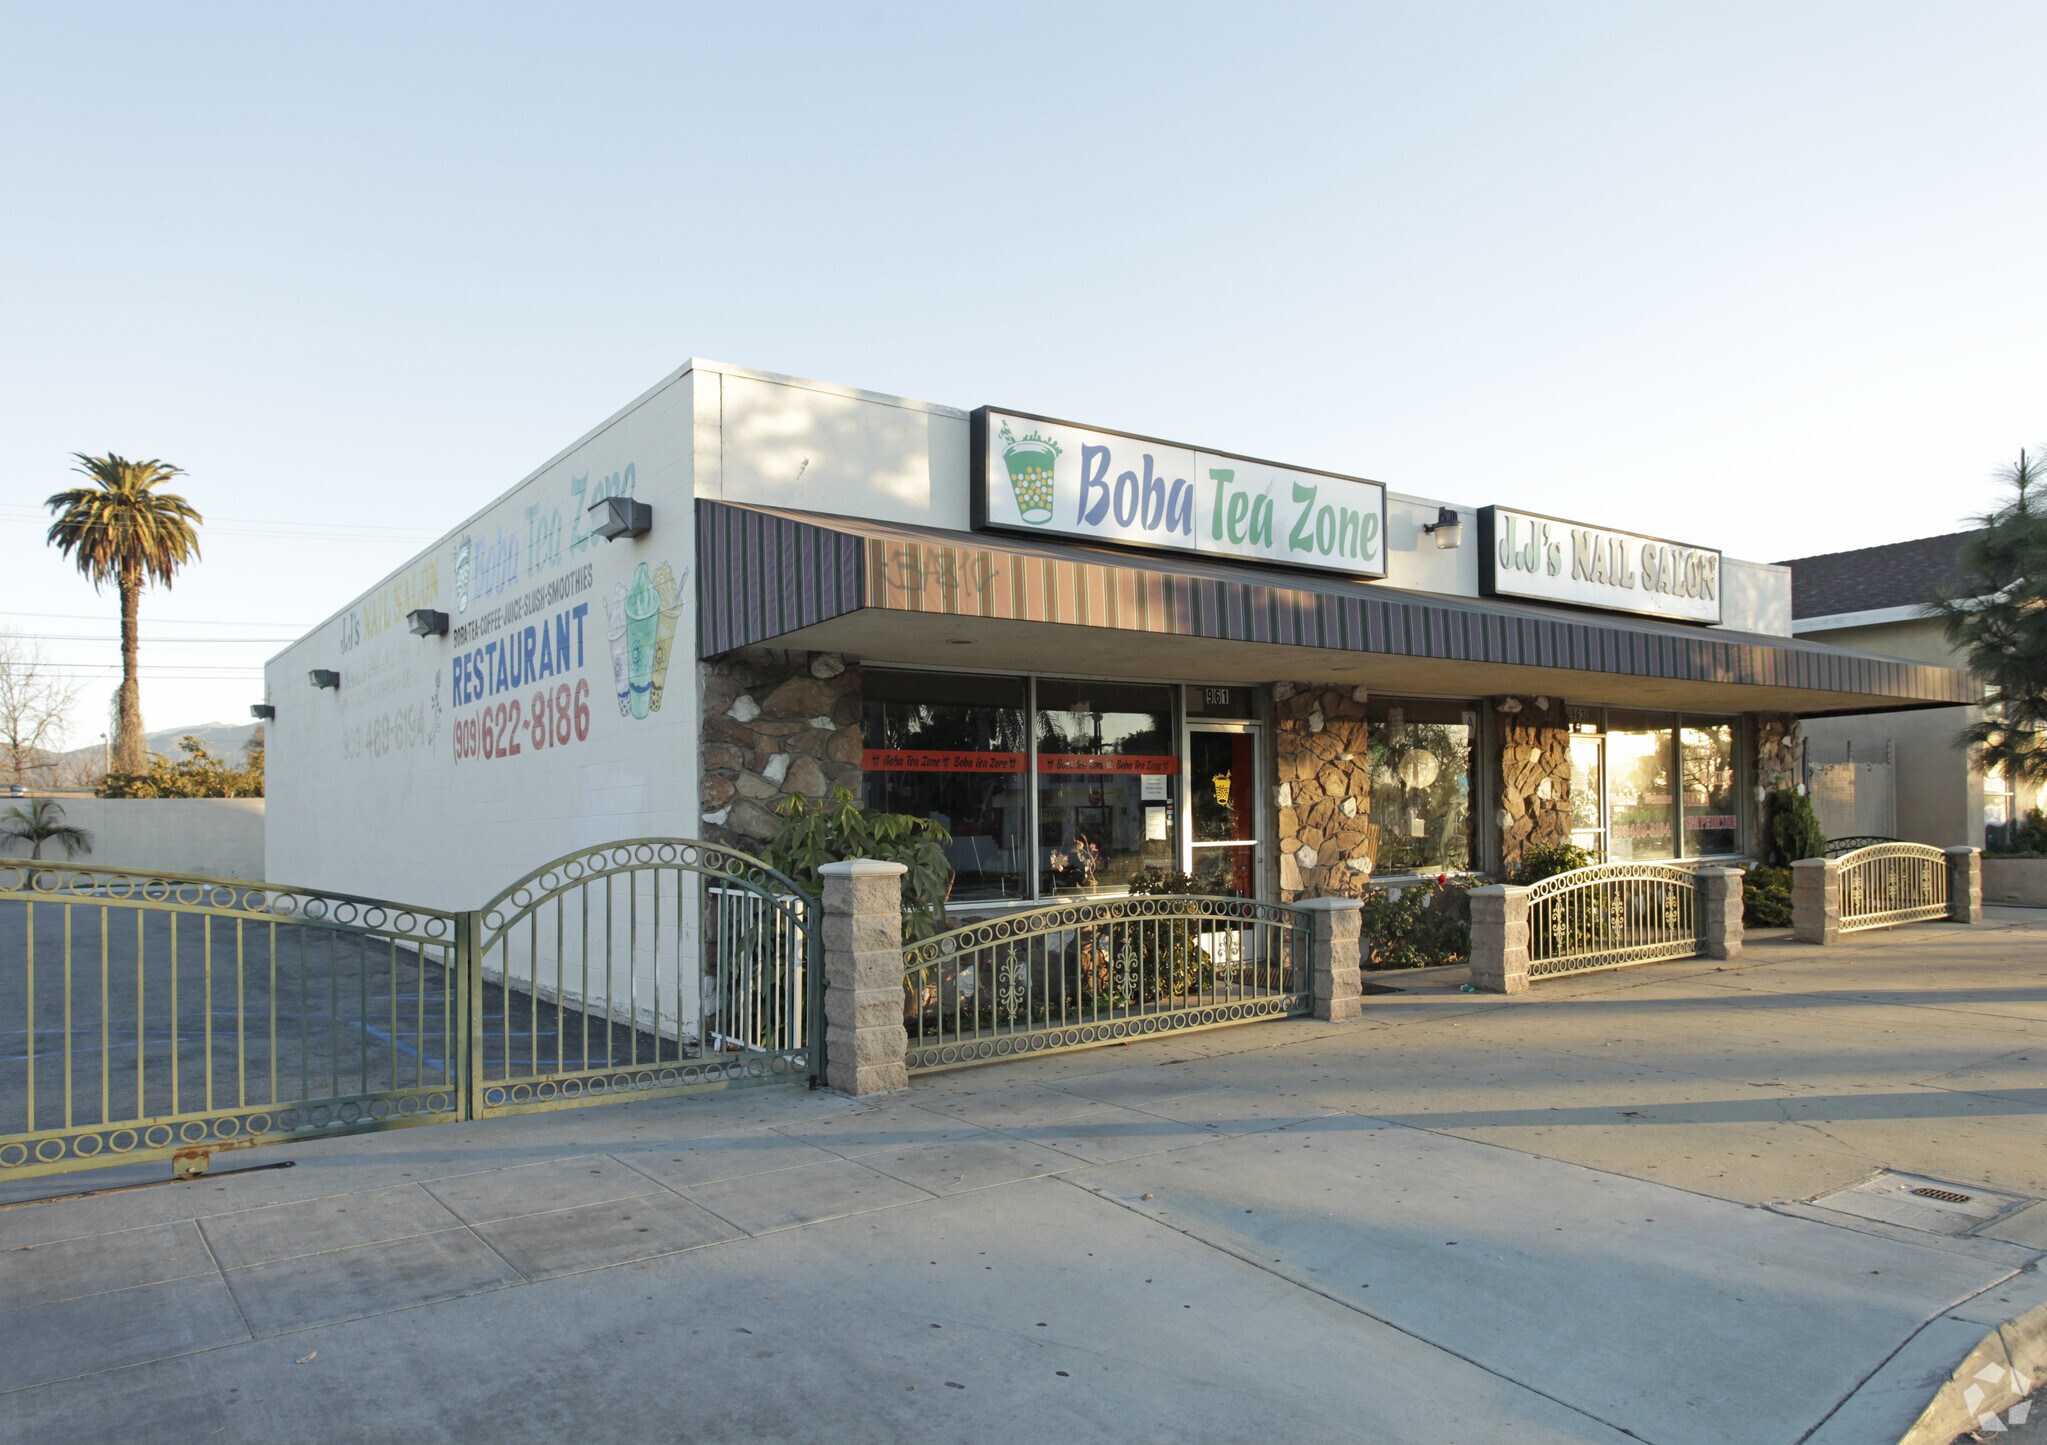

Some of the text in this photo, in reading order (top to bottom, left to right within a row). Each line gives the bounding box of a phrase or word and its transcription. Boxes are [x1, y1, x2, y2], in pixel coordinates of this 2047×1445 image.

[1077, 441, 1378, 561] Boba Tea Zone
[1500, 516, 1716, 600] J.J's NAIL SALON
[452, 602, 588, 708] RESTAURANT
[1207, 688, 1228, 704] 961
